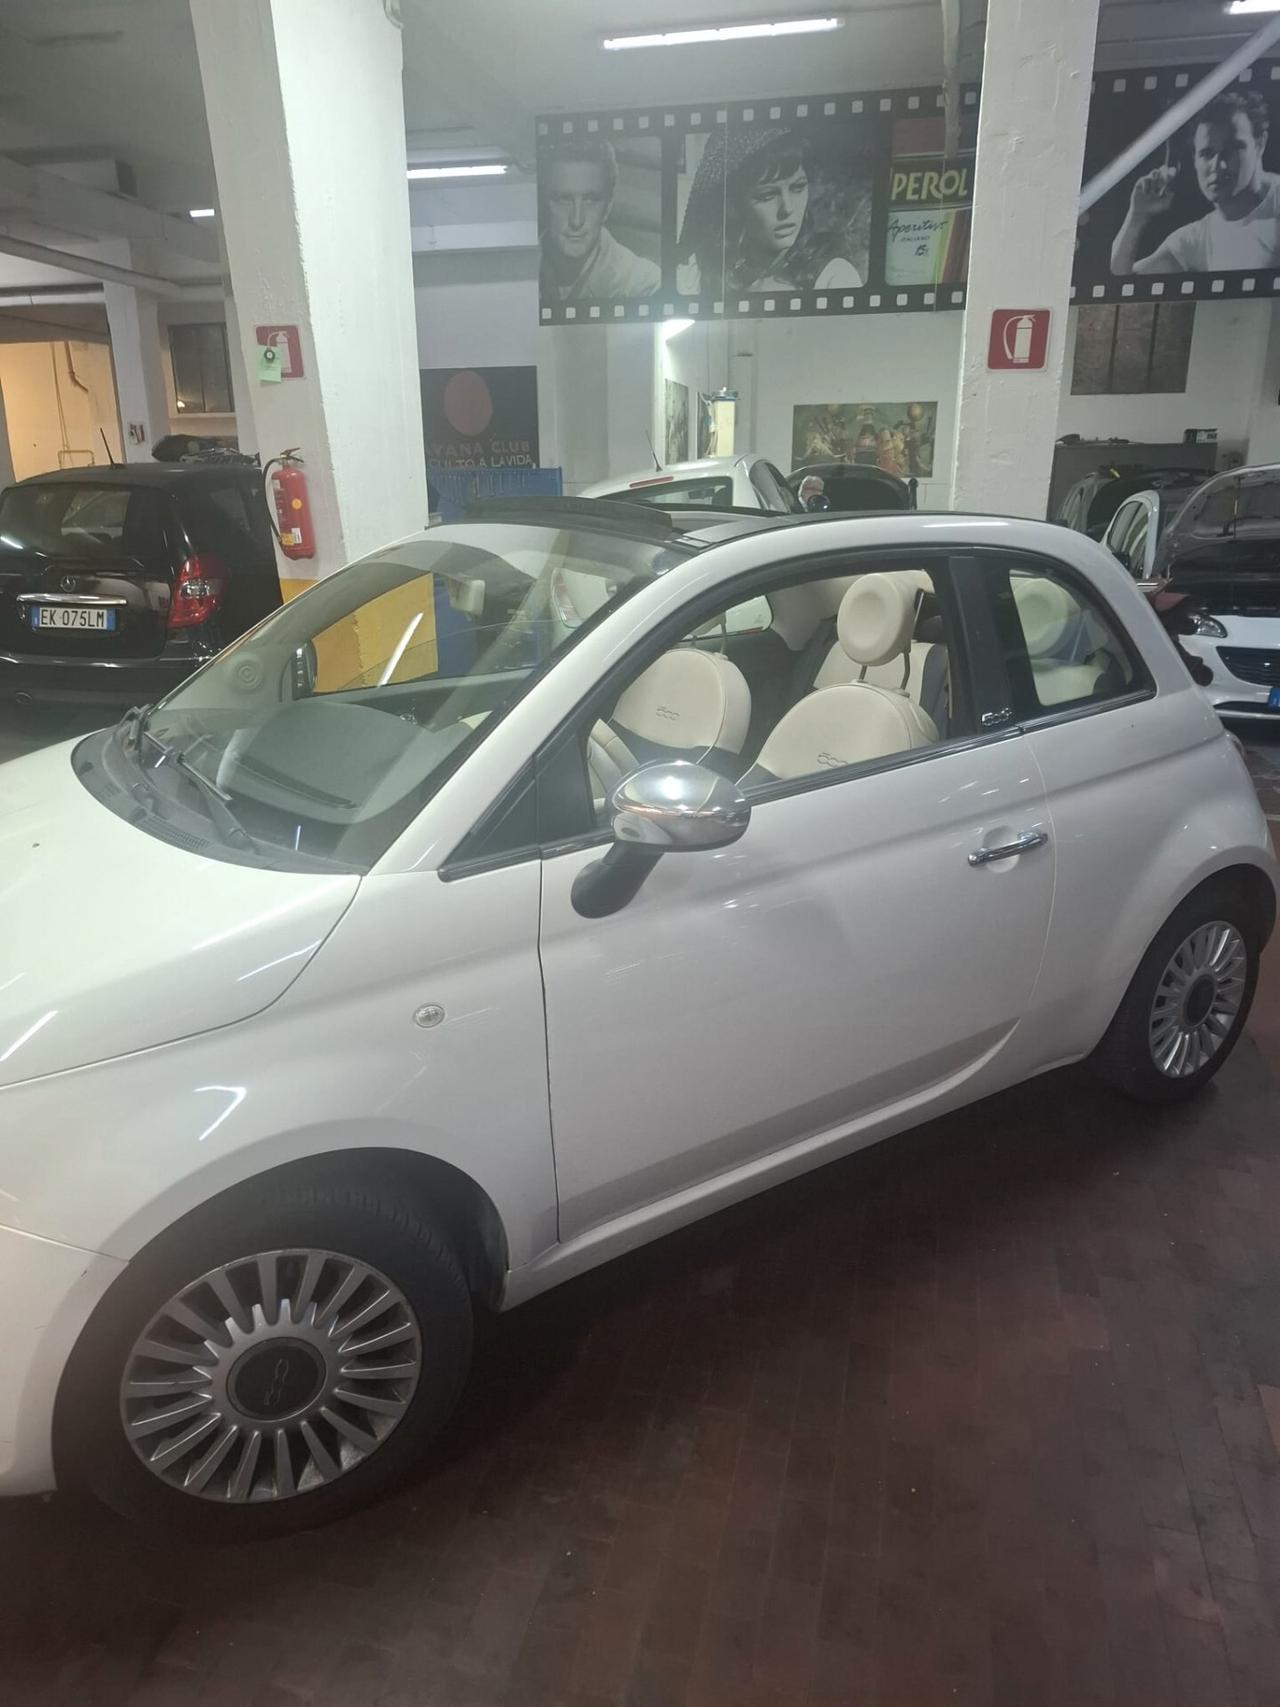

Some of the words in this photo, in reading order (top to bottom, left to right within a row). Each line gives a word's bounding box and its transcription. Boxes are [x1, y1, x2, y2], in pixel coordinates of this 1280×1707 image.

[889, 168, 968, 200] PEROL
[491, 440, 530, 454] CLUB
[41, 609, 57, 626] EK
[62, 610, 105, 628] 075LM
